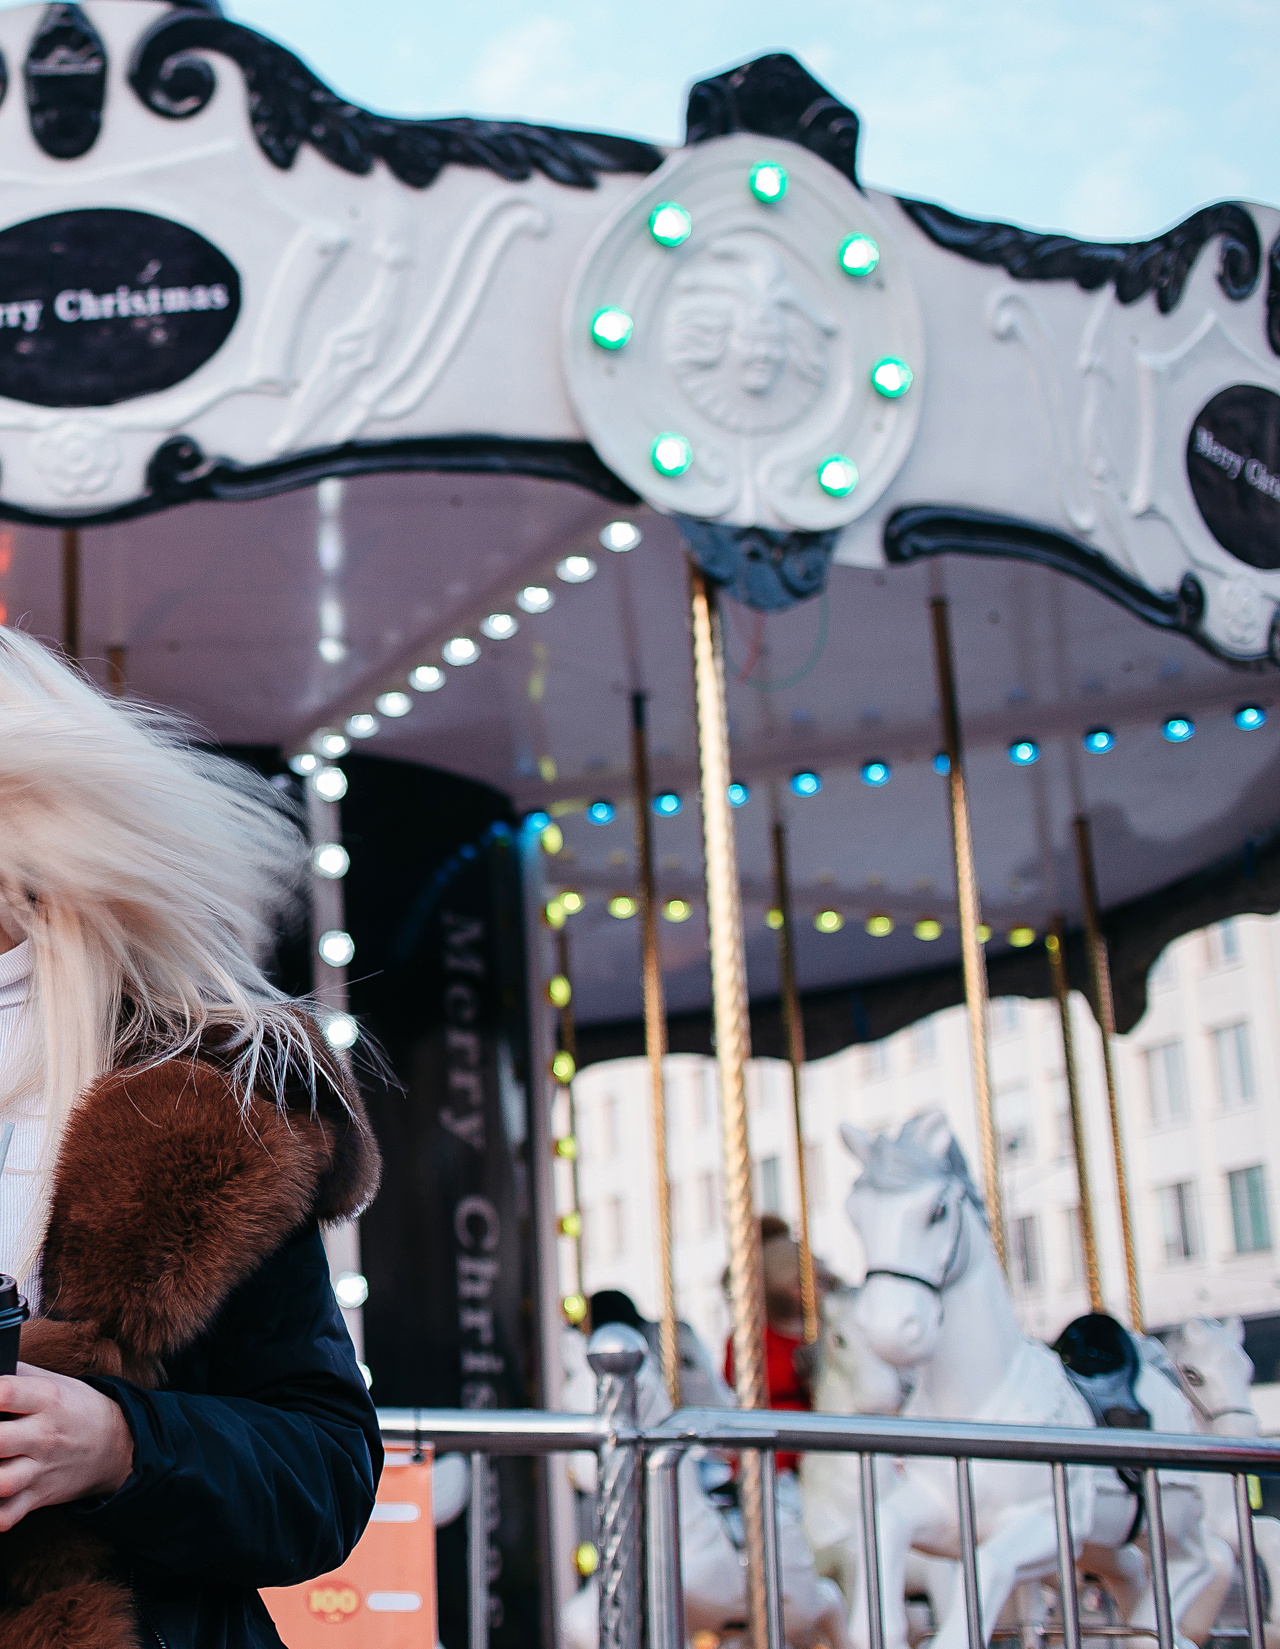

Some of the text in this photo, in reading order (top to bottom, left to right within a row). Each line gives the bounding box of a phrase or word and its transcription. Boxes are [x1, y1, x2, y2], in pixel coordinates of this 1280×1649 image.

[54, 284, 229, 322] Christmas
[1195, 426, 1244, 479] Merry
[436, 910, 487, 1154] Merry
[309, 1587, 358, 1613] 100
